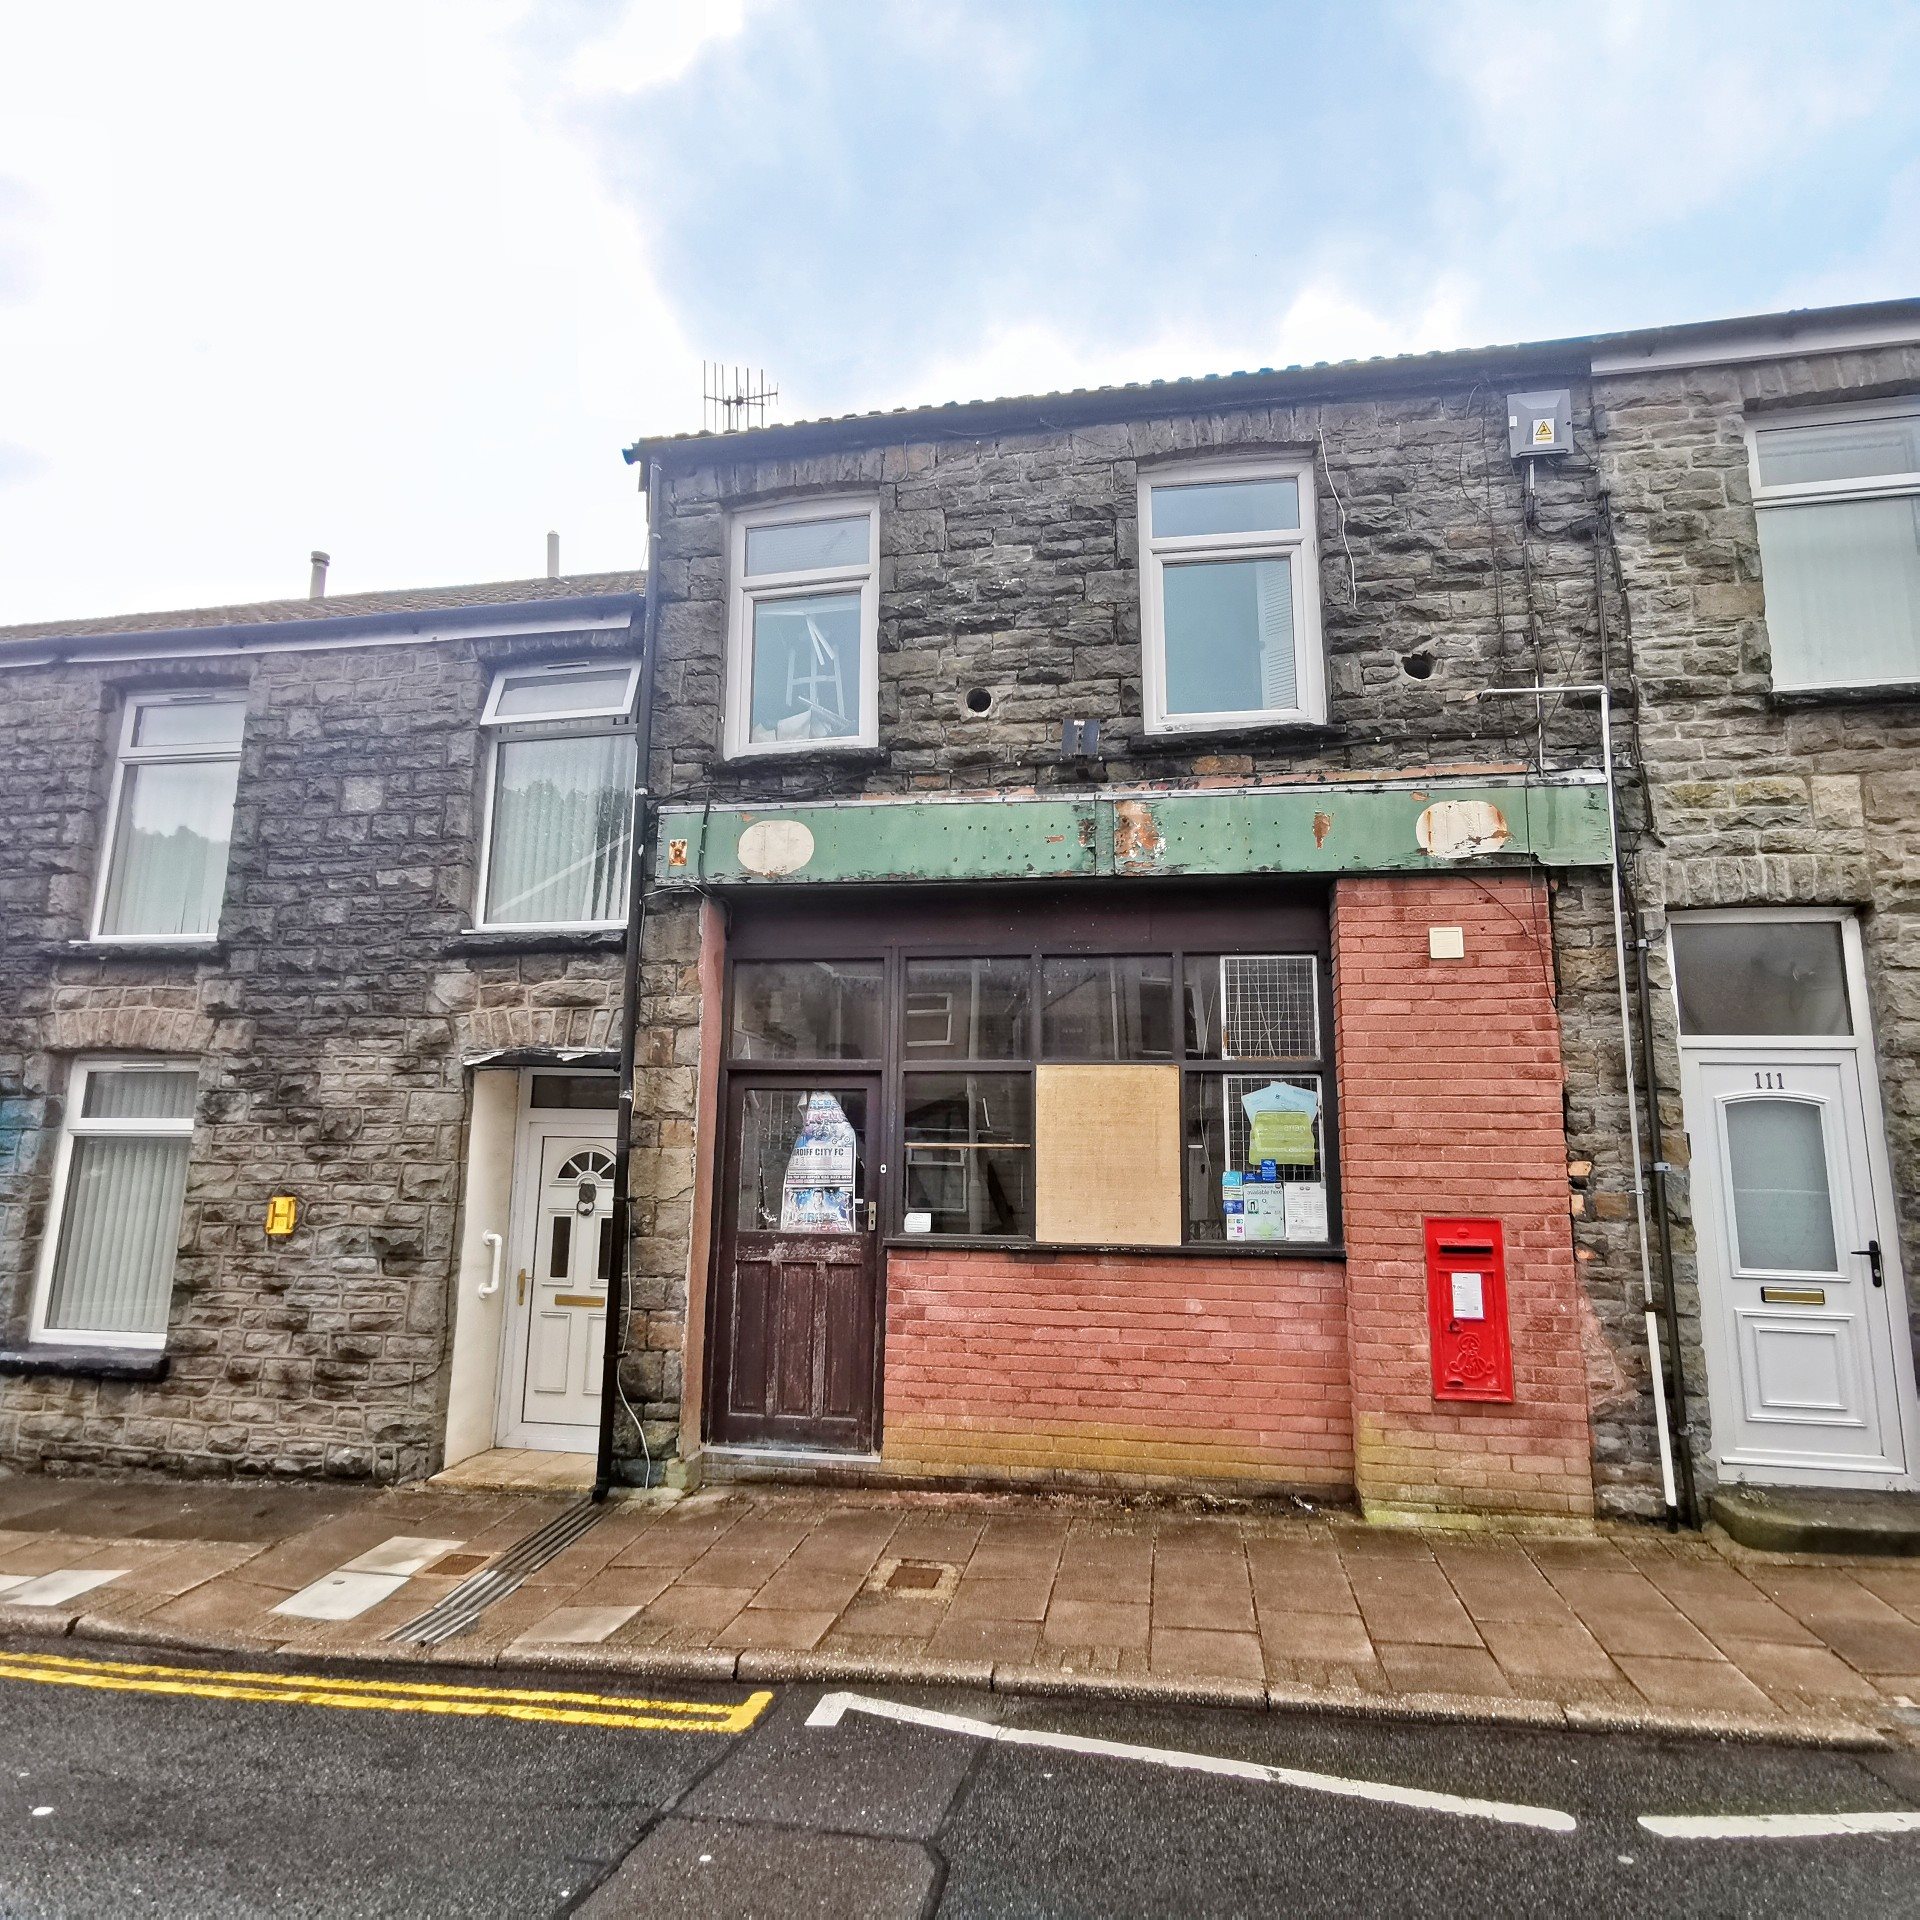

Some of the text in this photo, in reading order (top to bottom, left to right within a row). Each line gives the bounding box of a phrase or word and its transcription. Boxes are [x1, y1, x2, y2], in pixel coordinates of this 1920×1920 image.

[1754, 1072, 1785, 1089] 111
[792, 1148, 844, 1156] ARDIFF CITY FC
